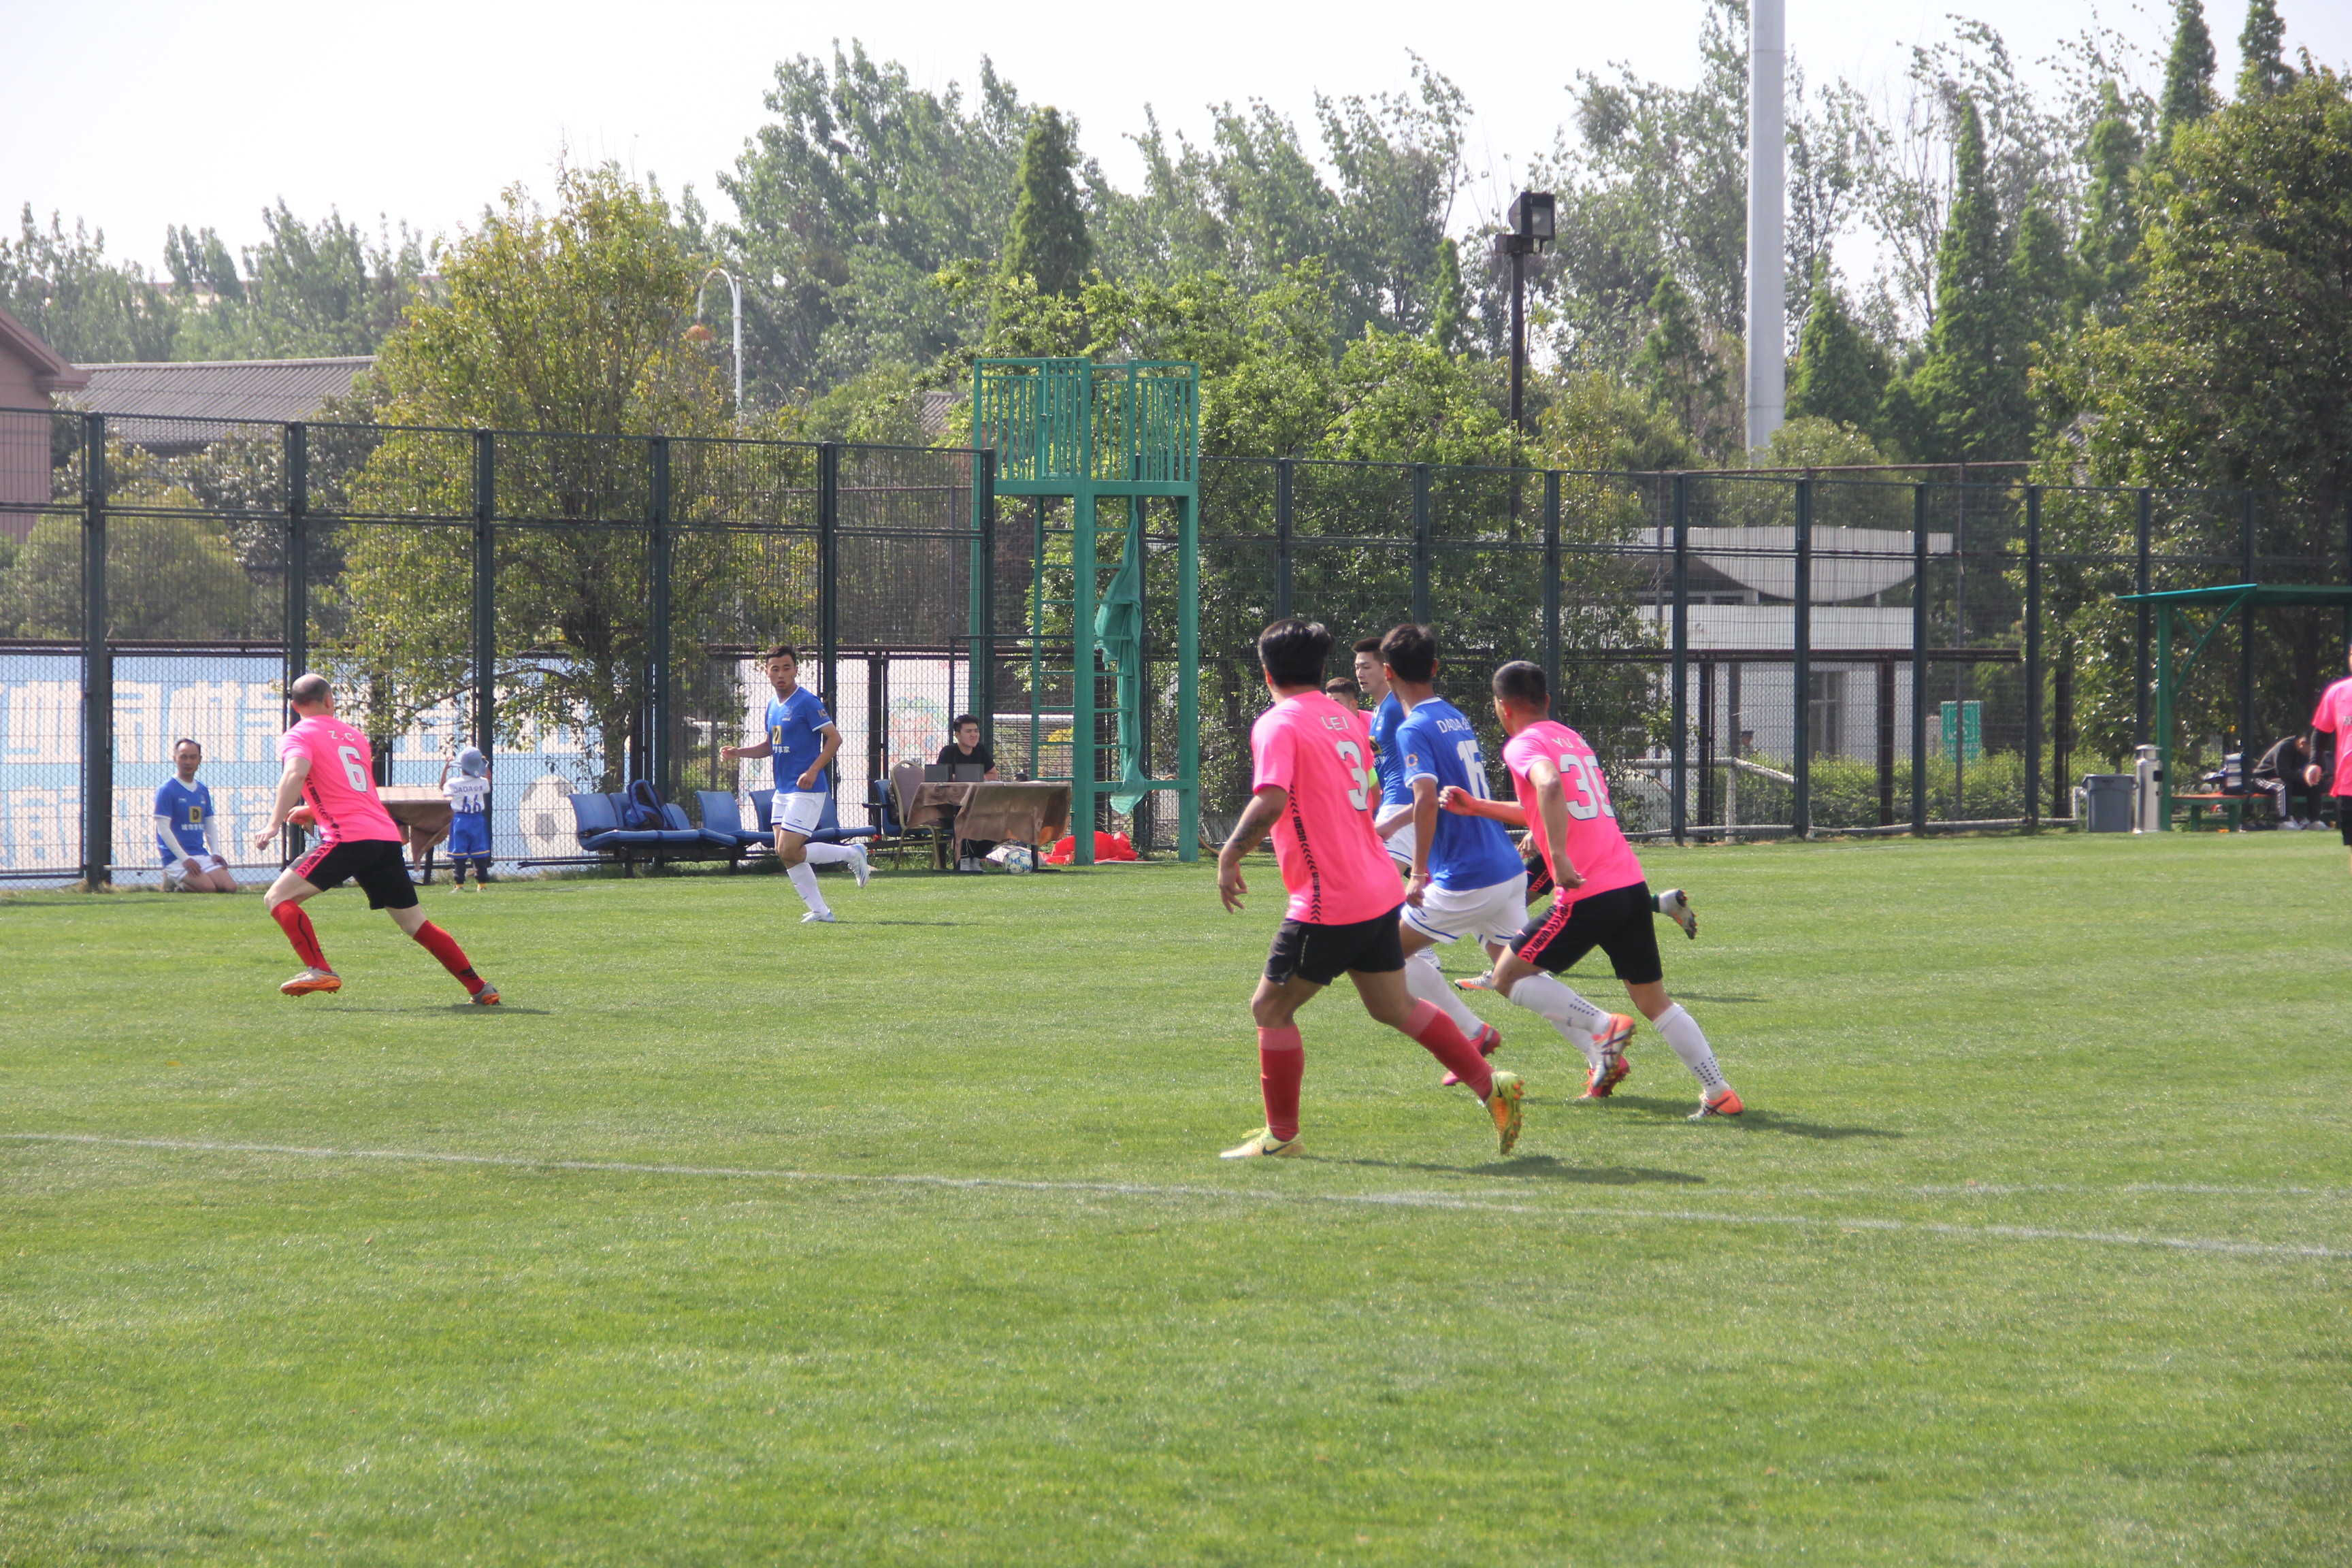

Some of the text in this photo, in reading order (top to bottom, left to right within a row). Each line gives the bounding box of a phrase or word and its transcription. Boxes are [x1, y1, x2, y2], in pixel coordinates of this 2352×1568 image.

[1320, 716, 1350, 731] LEI
[338, 746, 368, 793] 6
[1336, 740, 1370, 811] 3
